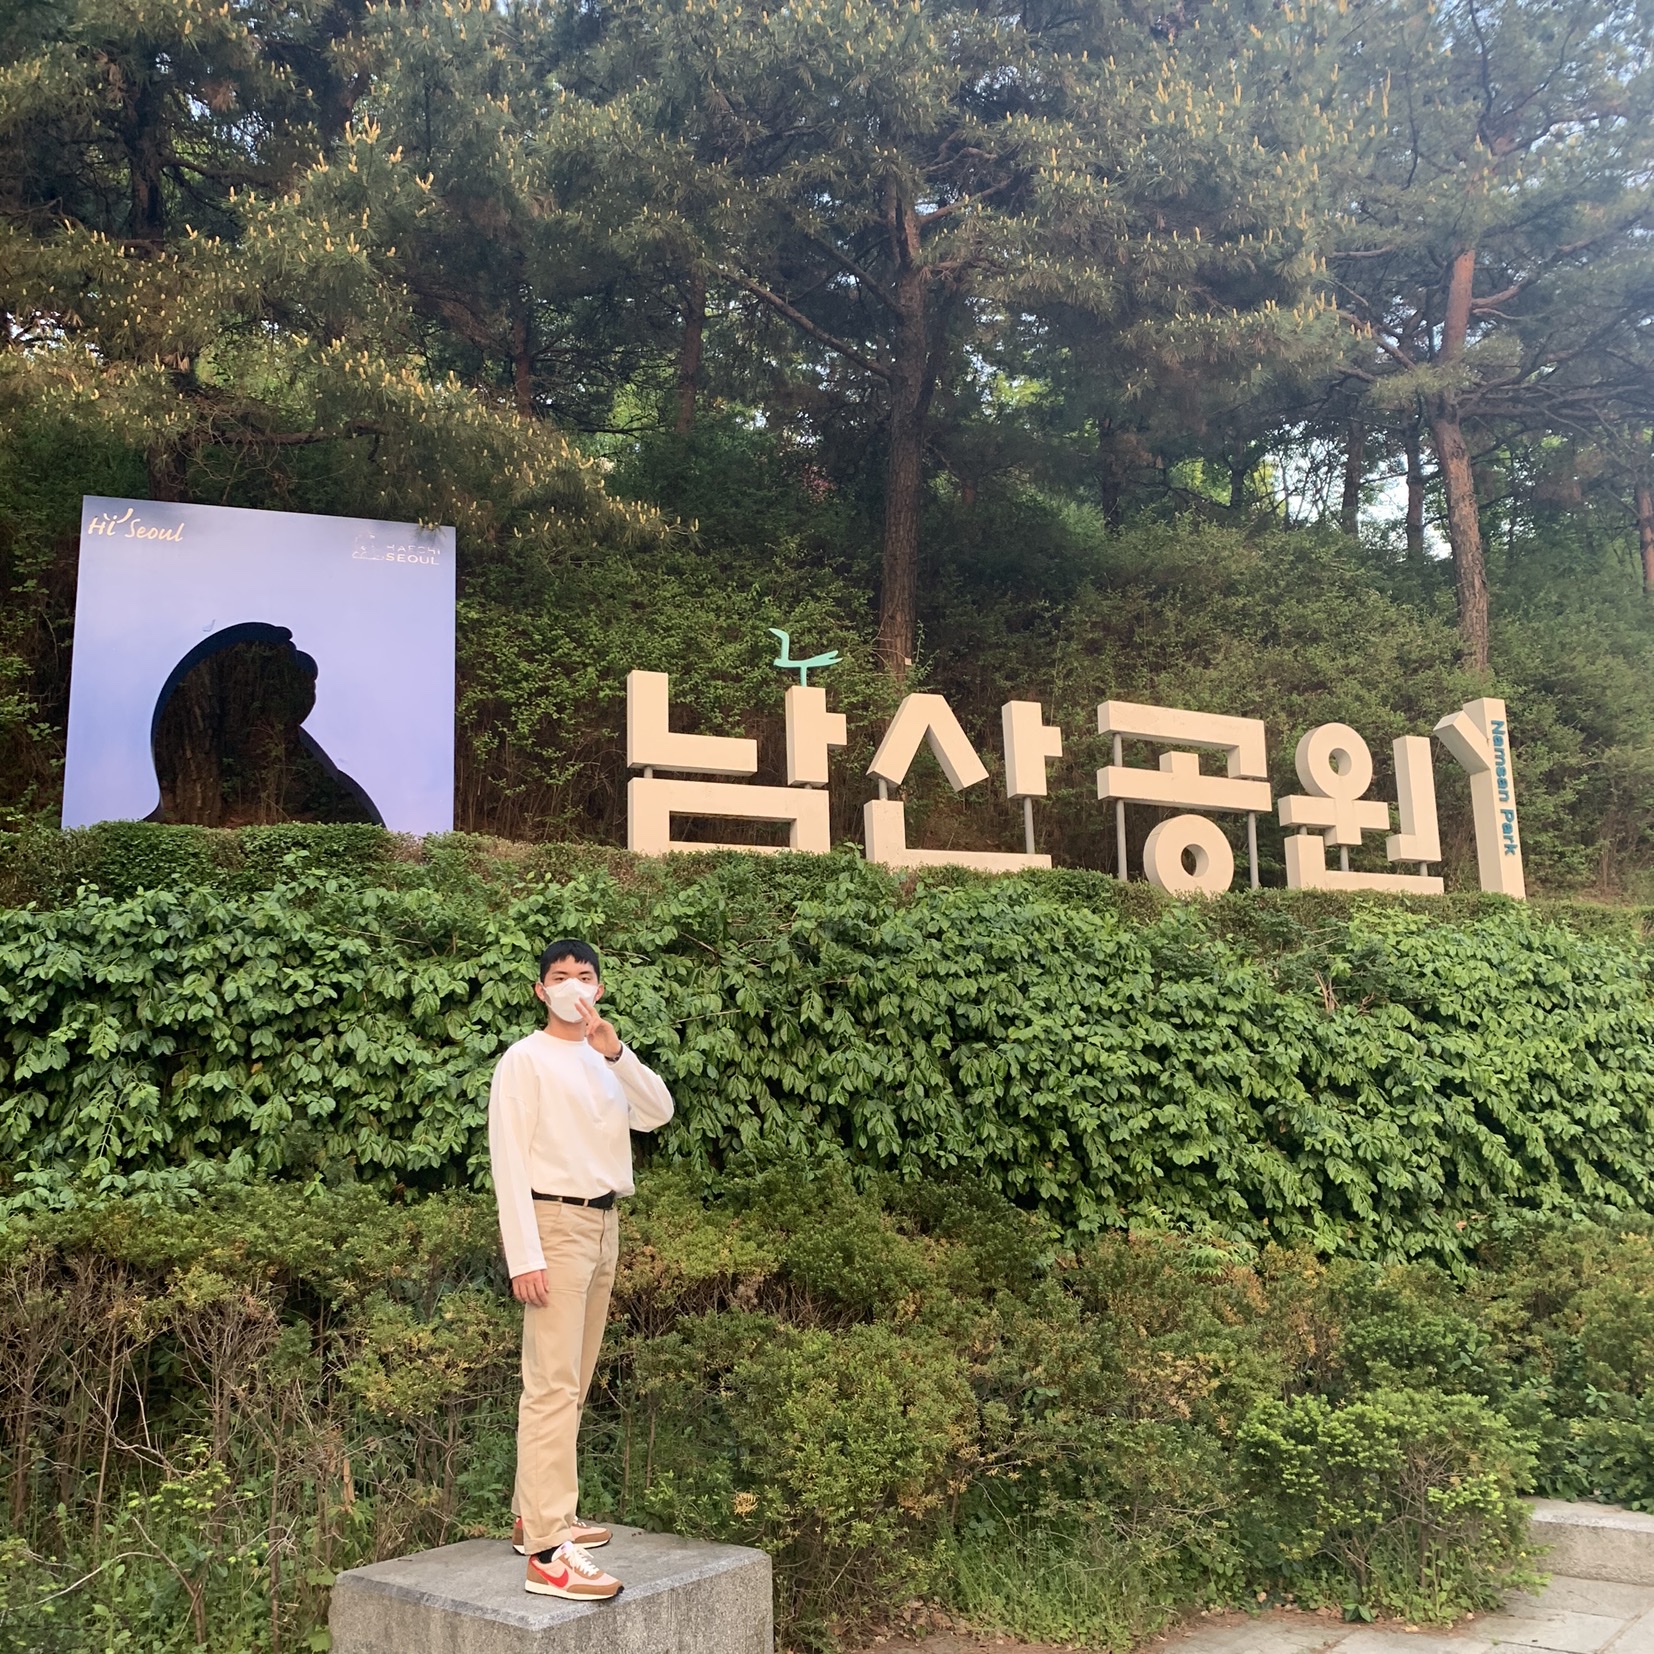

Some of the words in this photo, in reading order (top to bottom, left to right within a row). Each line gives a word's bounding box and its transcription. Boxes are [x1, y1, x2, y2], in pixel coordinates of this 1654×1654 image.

[125, 518, 185, 542] Seoul
[386, 552, 440, 566] SEOUL
[626, 670, 1445, 896] 남산공원
[1490, 719, 1510, 803] Namsan
[1499, 808, 1519, 856] Park
